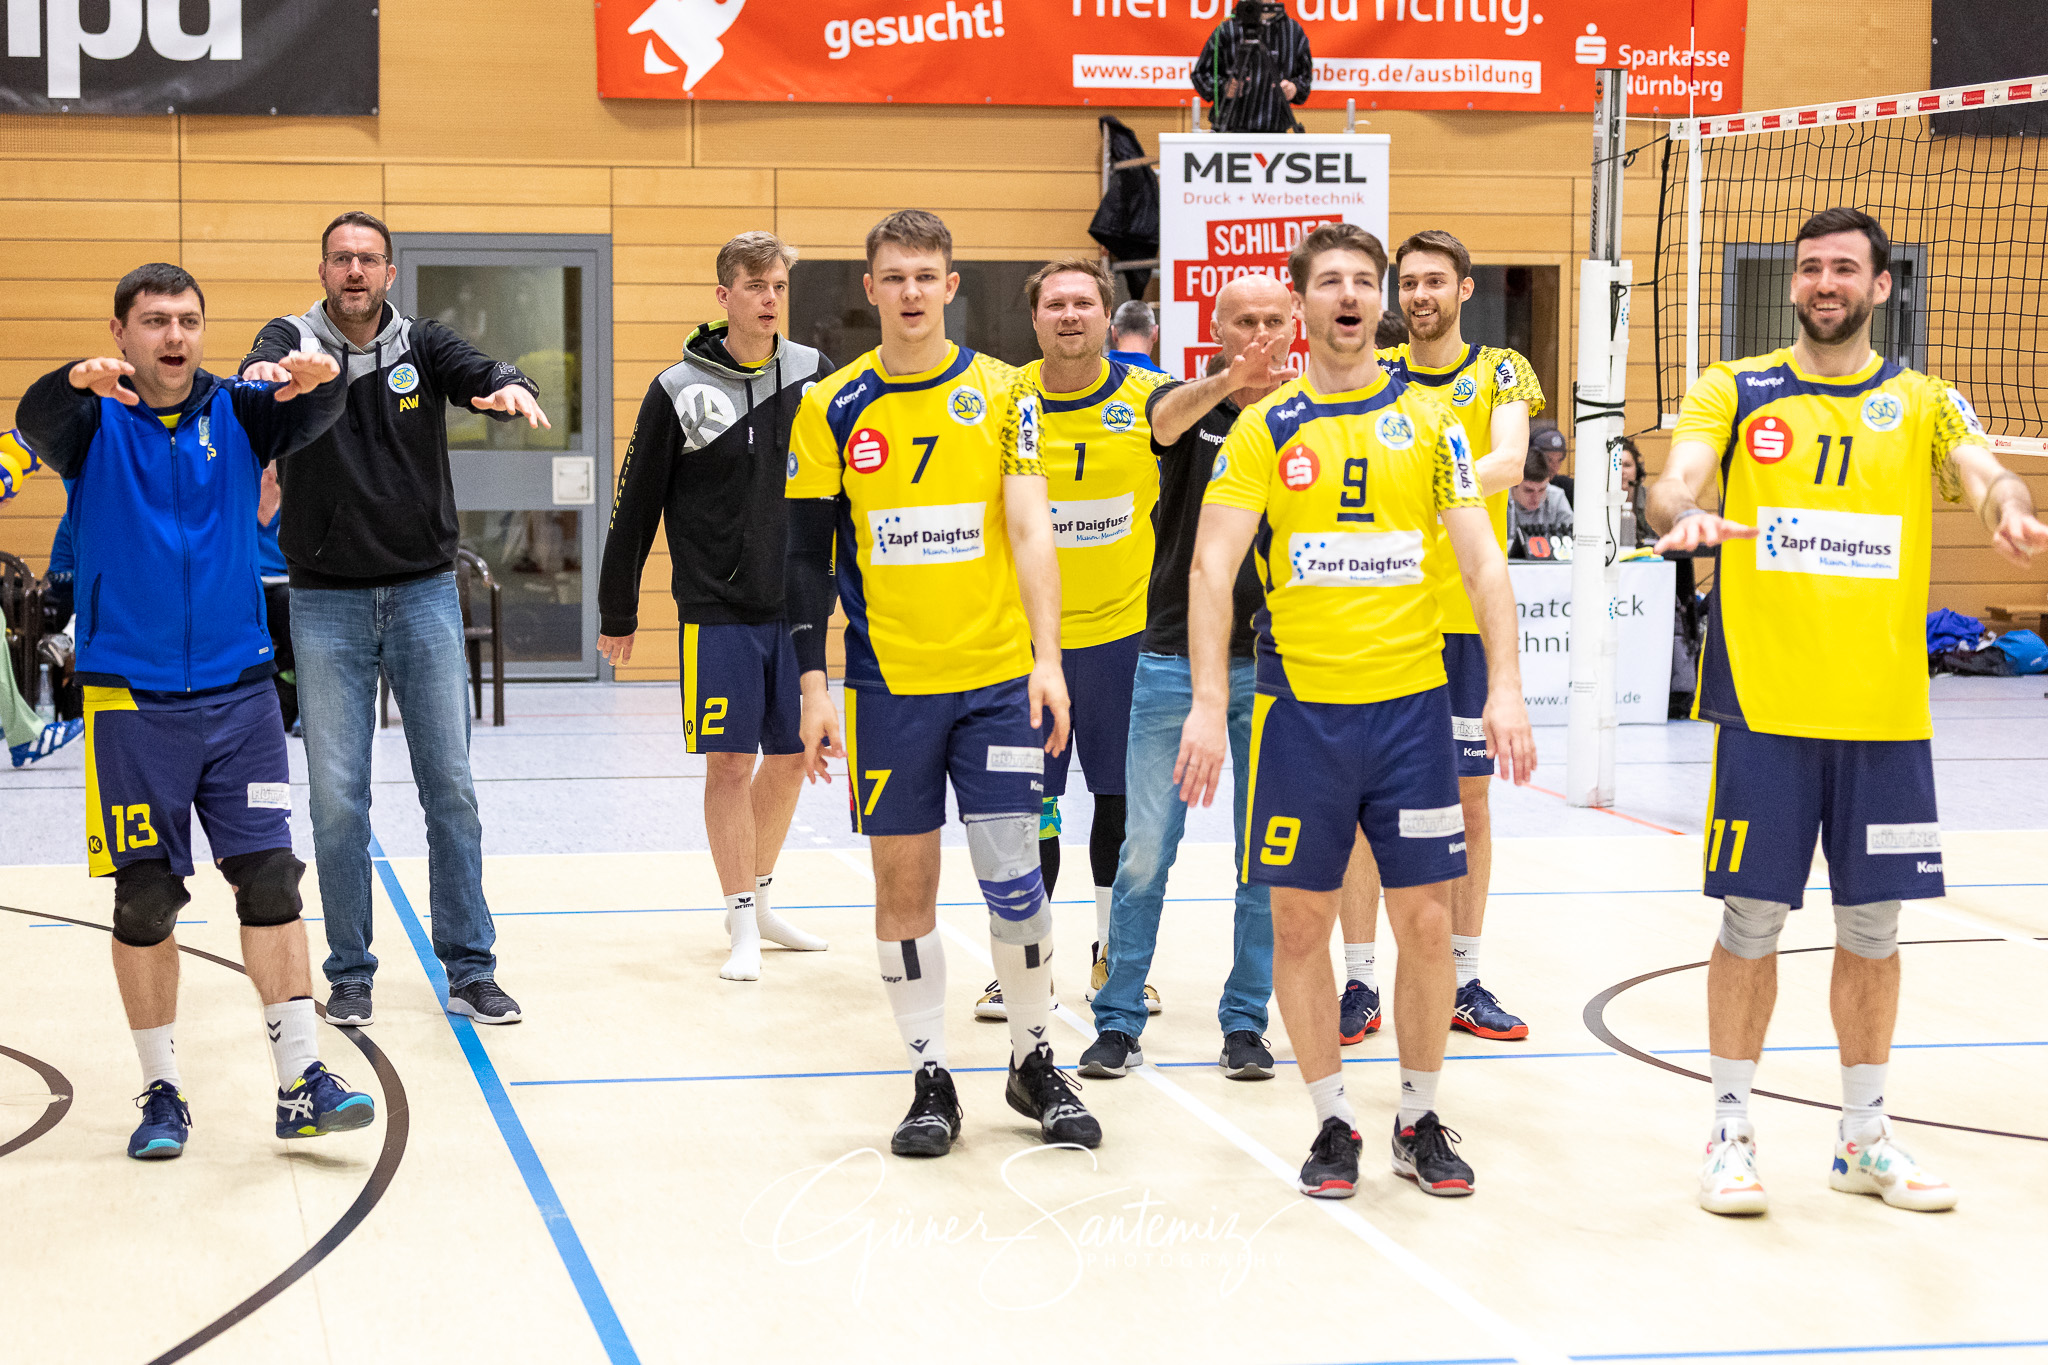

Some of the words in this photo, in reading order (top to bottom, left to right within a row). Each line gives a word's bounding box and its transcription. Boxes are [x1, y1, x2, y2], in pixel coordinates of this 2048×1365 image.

[825, 0, 1005, 59] gesucht!
[1618, 44, 1730, 70] Sparkasse
[1184, 153, 1366, 183] MEYSEL
[1184, 192, 1231, 204] Druck
[1252, 193, 1364, 205] Werbetechnik
[399, 394, 419, 412] AW
[911, 435, 939, 484] 7
[1074, 443, 1086, 481] 1
[1814, 434, 1853, 486] 11
[1340, 458, 1368, 507] 9
[887, 531, 918, 547] Zapf
[922, 528, 980, 545] Daigfuss
[1053, 520, 1073, 534] apf
[1781, 535, 1817, 552] Zapf
[1820, 538, 1892, 556] Daigfuss
[1307, 559, 1345, 572] Zapf
[1349, 558, 1417, 574] Daigfuss
[700, 697, 729, 735] 2
[1463, 747, 1487, 759] Kemp
[864, 770, 892, 815] 7
[111, 804, 158, 853] 13
[1260, 816, 1301, 866] 9
[1708, 819, 1749, 872] 11
